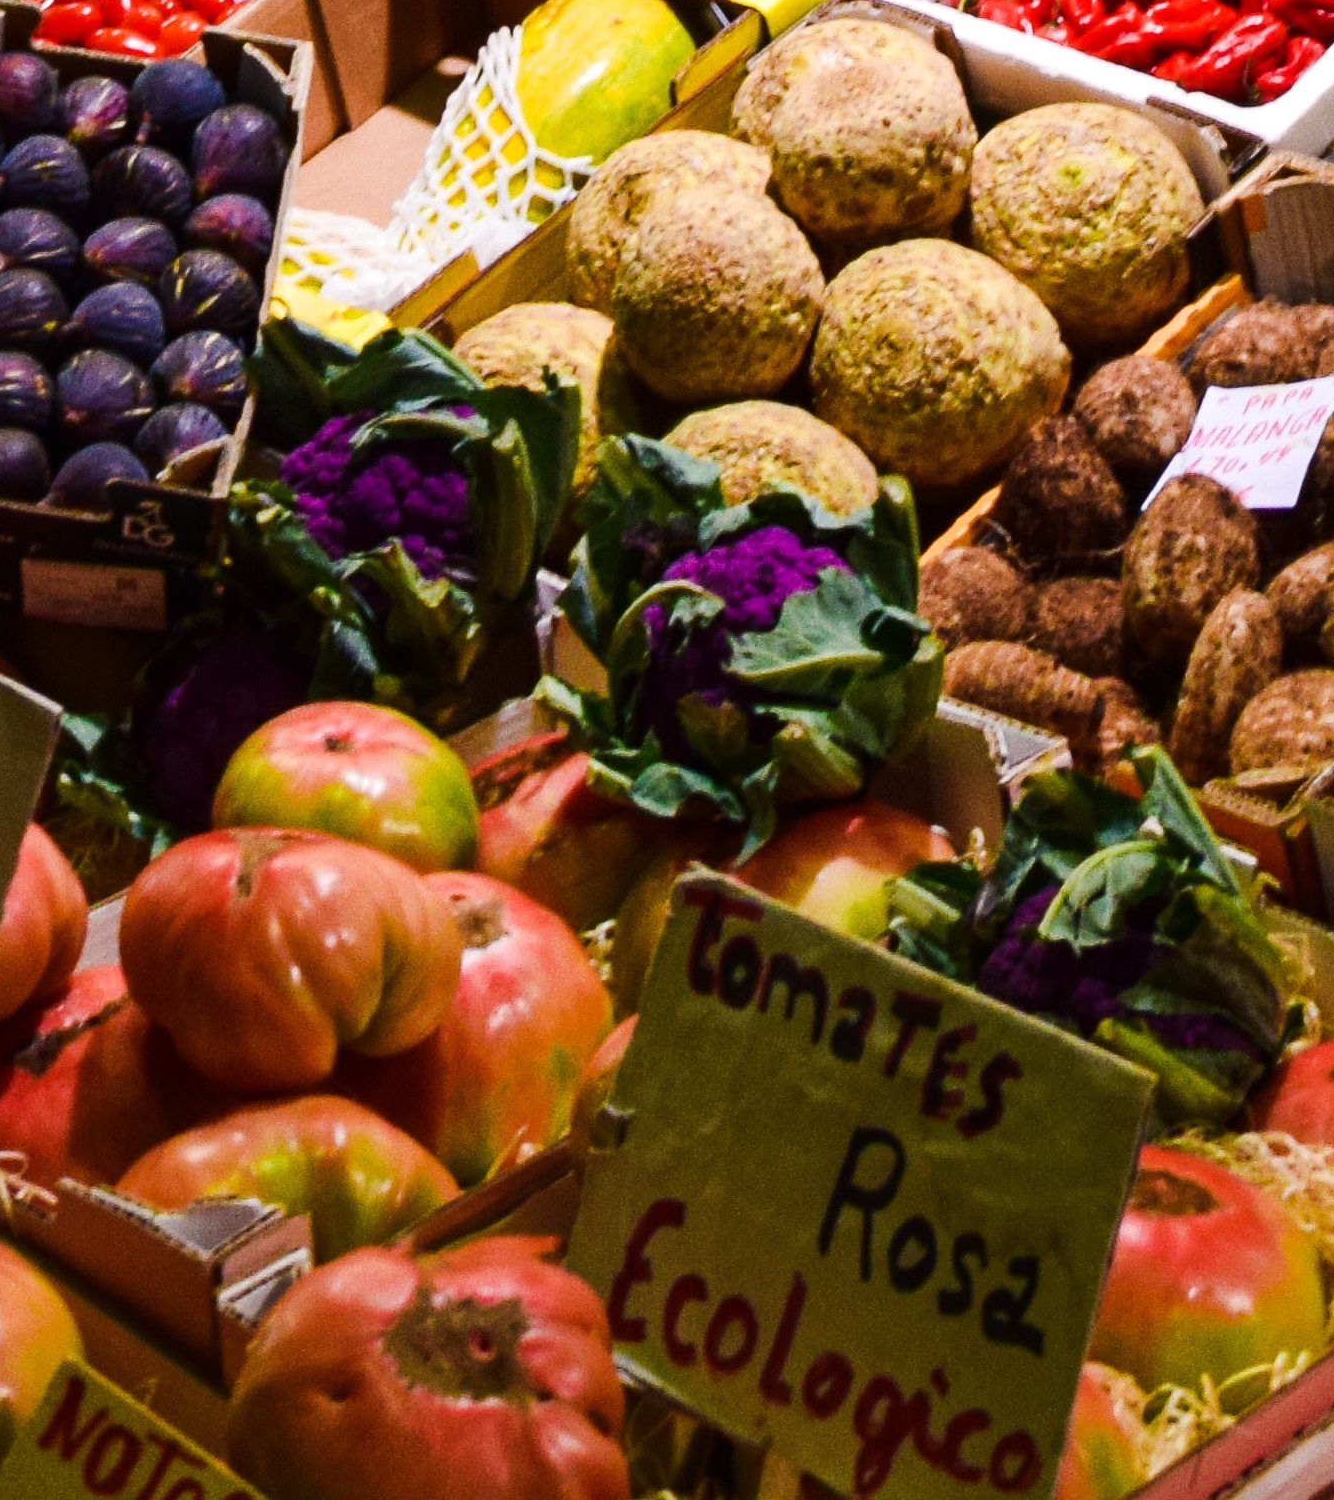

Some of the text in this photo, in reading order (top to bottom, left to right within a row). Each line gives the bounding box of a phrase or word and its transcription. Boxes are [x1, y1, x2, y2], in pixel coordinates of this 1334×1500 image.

[1180, 405, 1328, 452] MALANGA
[1242, 386, 1315, 416] PAPA
[816, 1125, 1046, 1359] Rosa
[609, 1196, 1045, 1499] Ecologico
